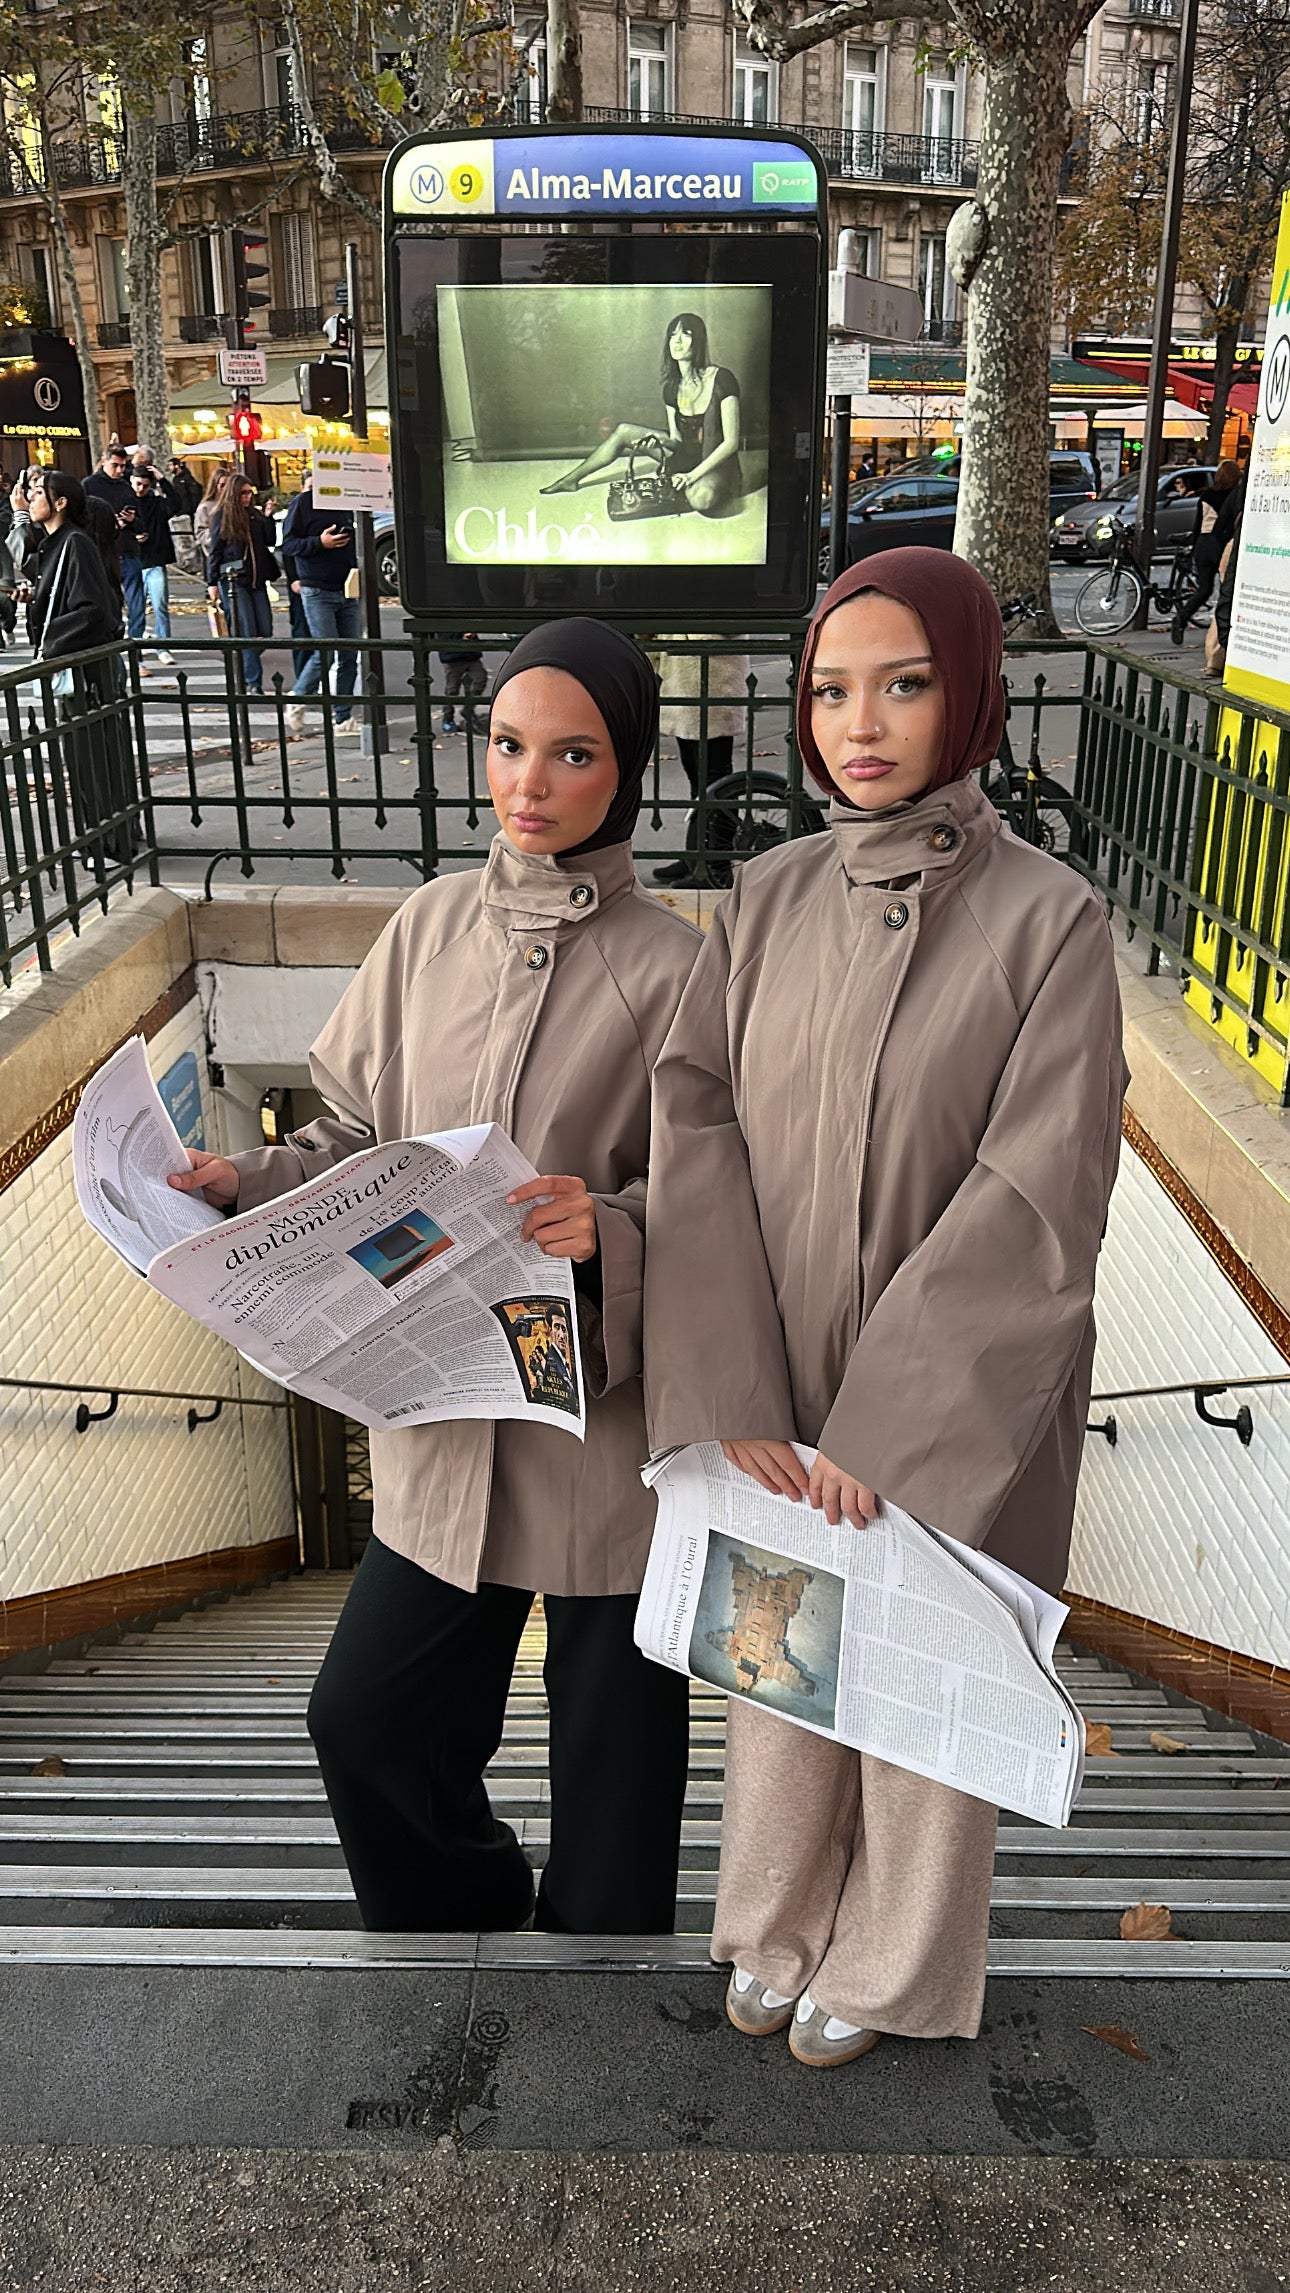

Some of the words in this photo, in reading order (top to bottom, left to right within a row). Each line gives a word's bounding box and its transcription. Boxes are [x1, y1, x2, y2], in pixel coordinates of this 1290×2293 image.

[460, 174, 473, 196] 9
[506, 168, 742, 199] Alma-Marceau
[782, 178, 810, 187] RATP
[1183, 346, 1200, 360] LE
[46, 426, 81, 437] CORONA
[454, 506, 600, 557] Chloé
[225, 1154, 413, 1271] diplomatique
[267, 1186, 353, 1234] MONDE
[359, 1225, 374, 1237] de
[375, 1216, 390, 1226] la
[392, 1198, 418, 1217] tech
[369, 1208, 387, 1223] Le
[390, 1185, 418, 1211] coup
[204, 1237, 216, 1246] LE
[231, 1261, 303, 1312] Narcotrafic,
[302, 1250, 321, 1264] un
[233, 1286, 275, 1325] ennemi
[275, 1249, 336, 1286] commode
[358, 1331, 386, 1352] mérite
[682, 1536, 698, 1582] l'Oural
[683, 1582, 690, 1593] à
